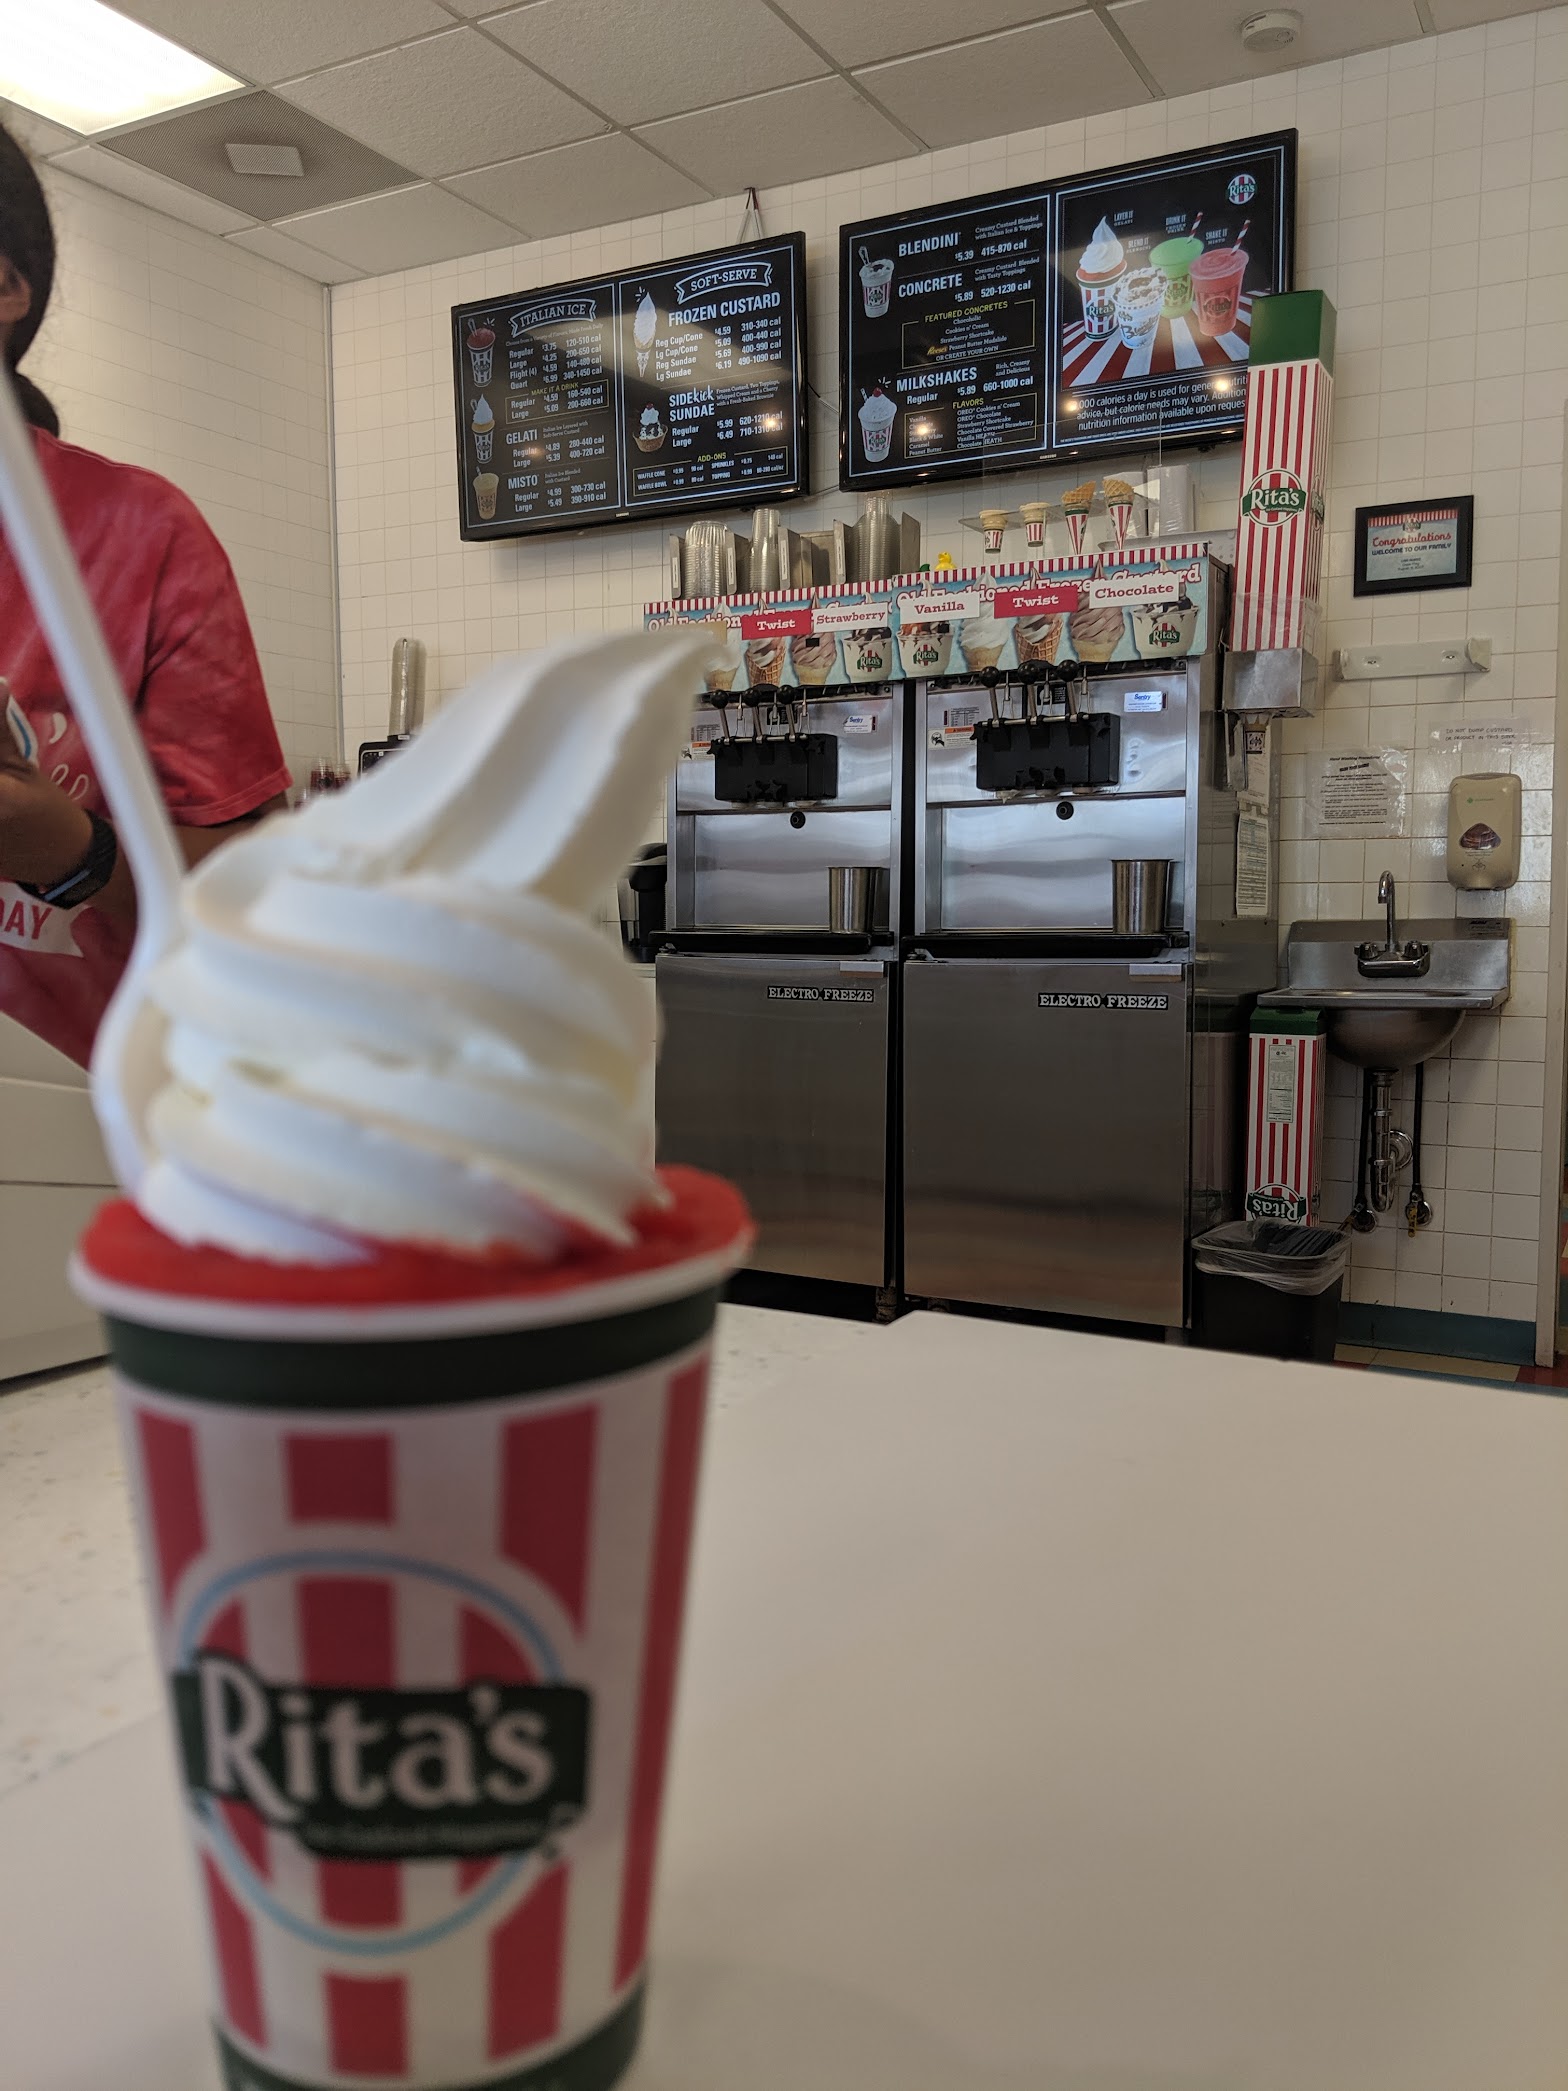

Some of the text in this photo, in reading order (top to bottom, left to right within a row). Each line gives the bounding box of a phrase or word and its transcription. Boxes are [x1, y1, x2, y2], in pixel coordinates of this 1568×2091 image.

[1229, 182, 1255, 197] Rita's
[996, 215, 1039, 229] Custard Blended
[899, 233, 959, 257] BLENDINI
[955, 239, 1027, 262] $5.39 415-870 cal
[996, 257, 1039, 270] Custard Blended
[691, 269, 757, 291] SOFT-SERVE
[899, 273, 962, 298] CONCRETE
[955, 280, 1031, 302] $5.89 520-1230 cal
[520, 304, 586, 327] ITALIAN ICE
[669, 292, 780, 327] FROZEN CUSTARD
[925, 301, 1008, 322] FEATURED CONCRETES
[656, 316, 781, 348] Reg Cup/Cone $4.59 310-340 cal
[945, 326, 965, 335] Cookies
[510, 348, 533, 358] Regular
[591, 334, 601, 342] cal
[656, 328, 781, 360] Lg Cup/Cone cal
[510, 344, 601, 369] Large cal
[656, 361, 668, 371] Reg
[671, 356, 696, 366] Sundae
[770, 339, 781, 349] cal
[945, 352, 966, 360] CREATE
[510, 370, 528, 380] Flight
[529, 367, 537, 377] (4)
[591, 355, 601, 364] cal
[656, 351, 781, 382] Lg Sundae $6.19 cal
[511, 366, 602, 389] Quart cal
[897, 367, 977, 392] MILKSHAKES
[511, 399, 535, 409] Regular
[592, 385, 602, 394] cal
[532, 387, 547, 395] MAKE
[561, 382, 579, 390] DRINK
[669, 385, 714, 407] SIDEkick
[907, 376, 1033, 405] Regular $5.89 660-1000 cal
[1096, 394, 1126, 407] calories
[1133, 390, 1148, 401] day
[1150, 389, 1156, 398] is
[1157, 385, 1176, 397] used
[1178, 383, 1189, 393] for
[1191, 382, 1216, 394] gener
[512, 410, 528, 419] Large
[592, 396, 603, 404] cal
[670, 403, 715, 422] SUNDAE
[953, 398, 984, 409] FLAVORS
[1077, 388, 1246, 420] advice, but calorie needs may vary. Addition
[672, 425, 699, 437] Regular
[717, 419, 733, 428] $5.99
[772, 411, 782, 419] cal
[976, 412, 1001, 420] Chocolate
[1078, 418, 1111, 431] nutrition
[1112, 411, 1158, 426] information
[1159, 405, 1194, 419] available
[1195, 404, 1217, 415] upon
[1218, 399, 1246, 410] reques
[506, 429, 537, 444] GELATI
[673, 438, 691, 448] Large
[717, 430, 733, 439] $6.49
[772, 422, 782, 431] cal
[957, 428, 982, 436] Chocolate
[1005, 420, 1033, 429] Strawberry
[513, 447, 537, 457] Regular
[594, 435, 604, 444] cal
[514, 459, 531, 467] Large
[594, 446, 604, 455] cal
[698, 452, 726, 462] ADD-ONS
[508, 475, 537, 489] MISTO
[515, 492, 539, 502] Regular
[595, 481, 605, 490] cal
[515, 504, 532, 512] Large
[596, 492, 606, 500] cal
[1251, 488, 1300, 510] Rita's
[1372, 532, 1451, 547] Congratulations
[1013, 593, 1060, 608] Twist
[1094, 583, 1174, 599] Chocolate
[816, 609, 885, 626] Strawberry
[914, 600, 965, 616] Vanilla
[756, 618, 796, 631] Twist
[1153, 628, 1178, 642] Rita's
[860, 655, 882, 668] Rita's
[916, 650, 937, 663] Rita's
[1134, 693, 1152, 701] Sentry
[768, 987, 874, 1001] ELECTRO FREEZE
[1039, 994, 1167, 1009] ELECTRO FREEZE
[1252, 1197, 1299, 1221] Rita's
[200, 1655, 555, 1823] Rita's
